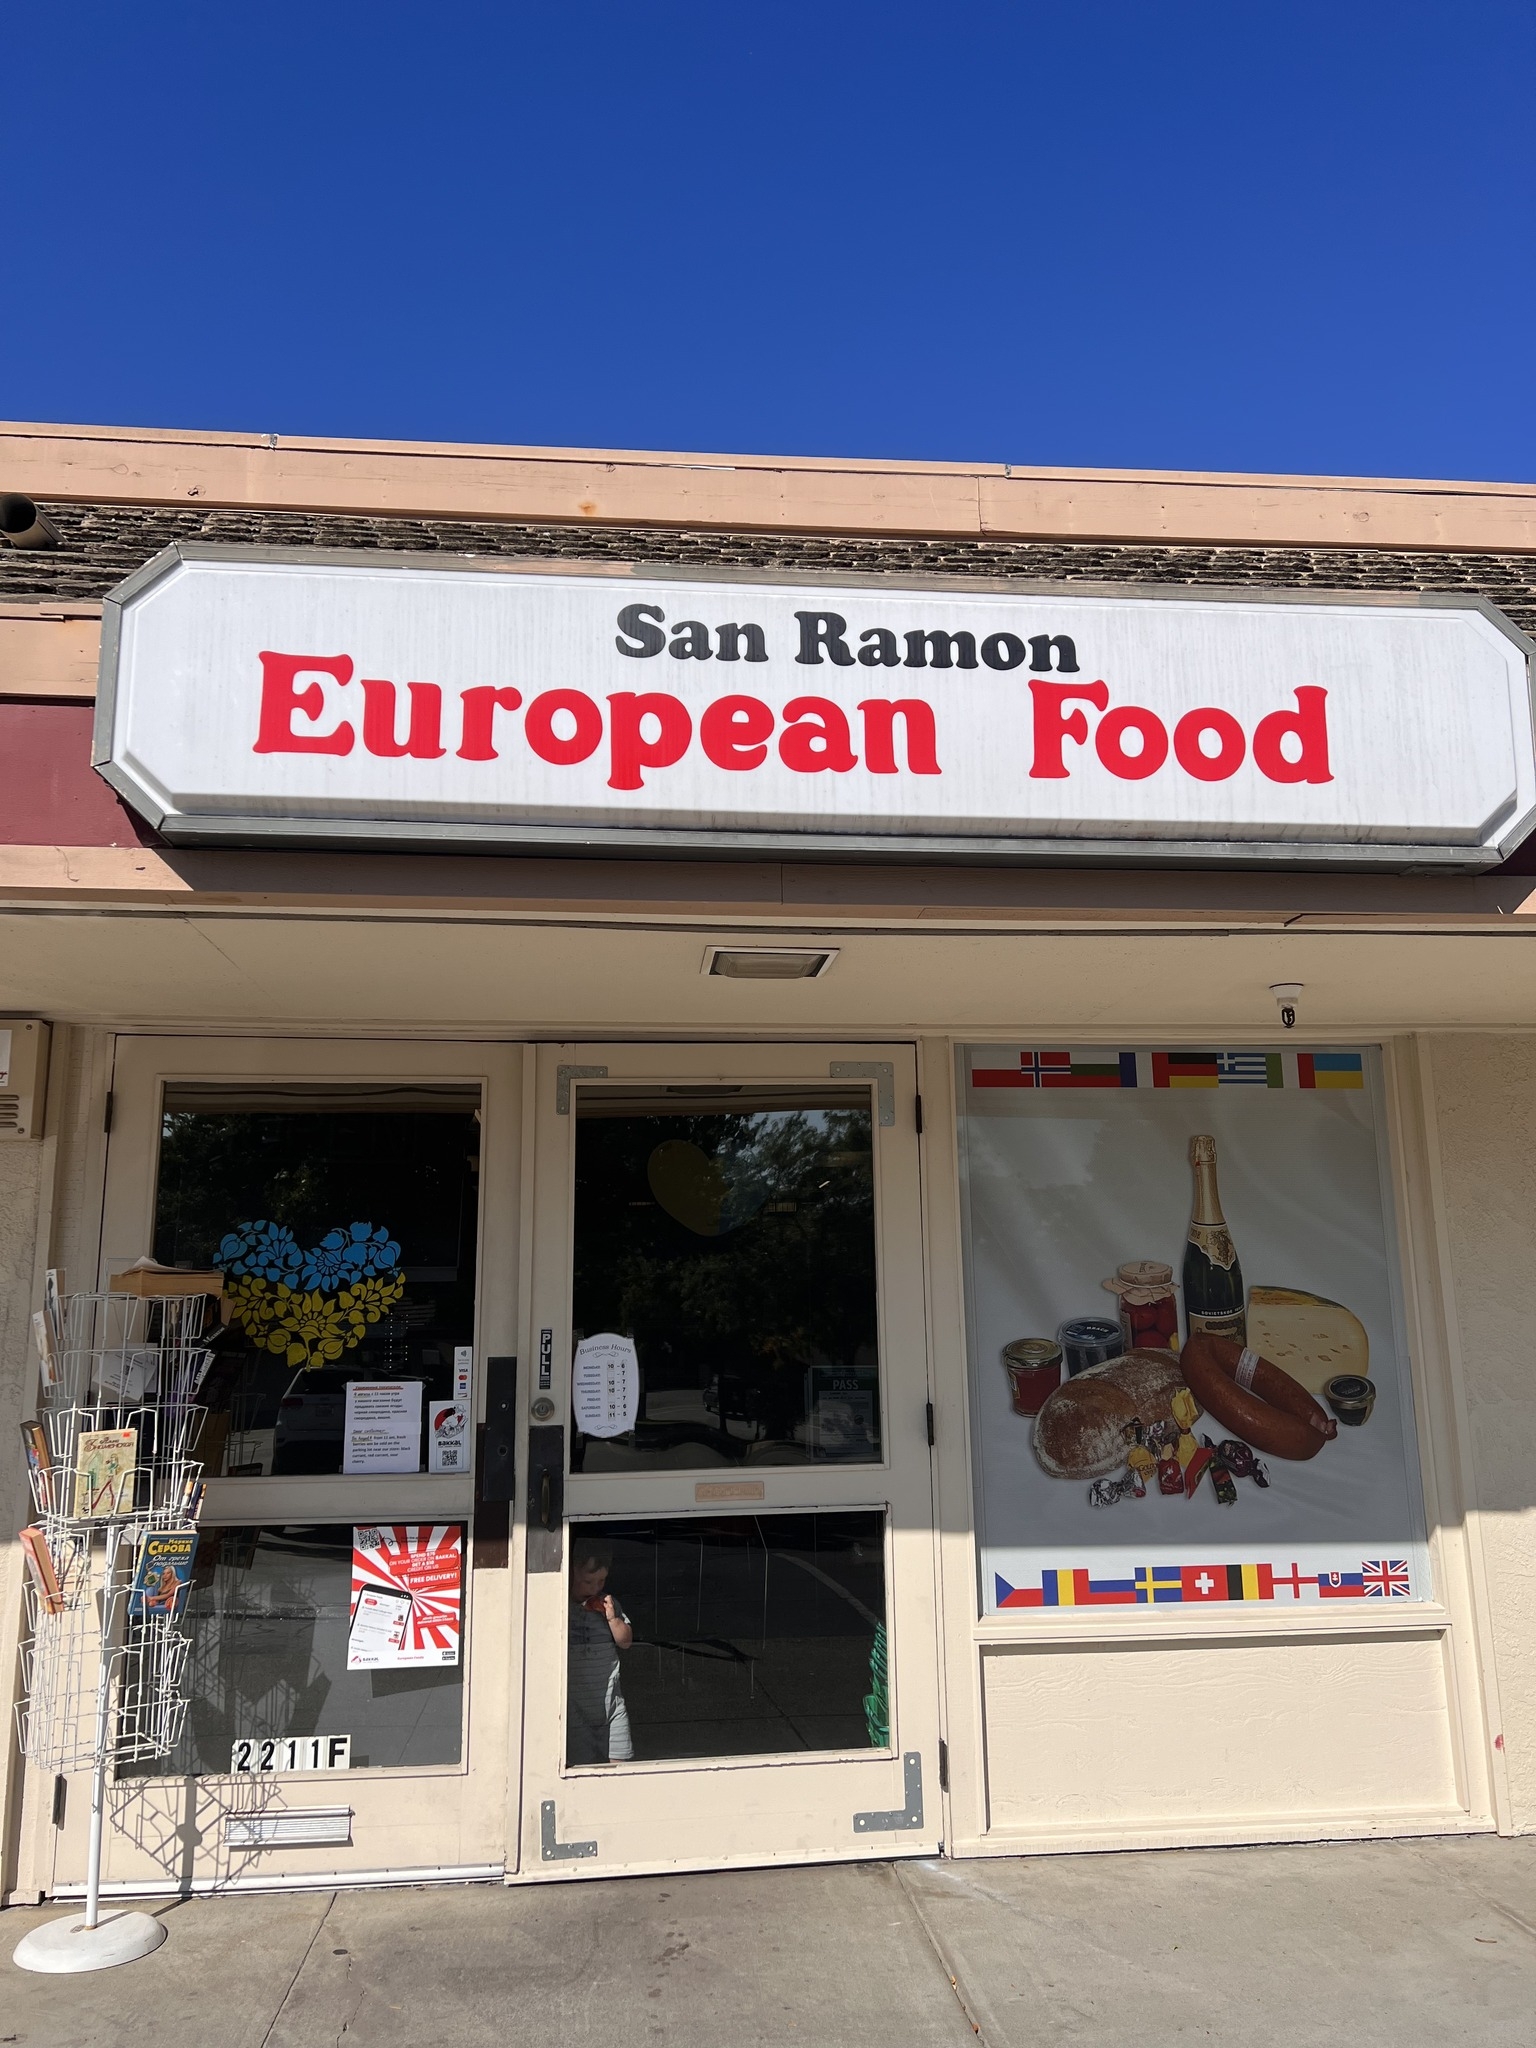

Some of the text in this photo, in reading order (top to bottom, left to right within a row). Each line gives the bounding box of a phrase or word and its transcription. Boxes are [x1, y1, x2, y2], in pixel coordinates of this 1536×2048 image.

[615, 603, 1081, 673] San Ramon
[253, 651, 1334, 791] European Food
[542, 1333, 551, 1376] PULL
[580, 1344, 632, 1355] Business Hours
[833, 1380, 858, 1390] PASS
[148, 1540, 191, 1555] СЕРОВА
[426, 1573, 457, 1582] DELIVERY!
[237, 1738, 348, 1771] 2211F
